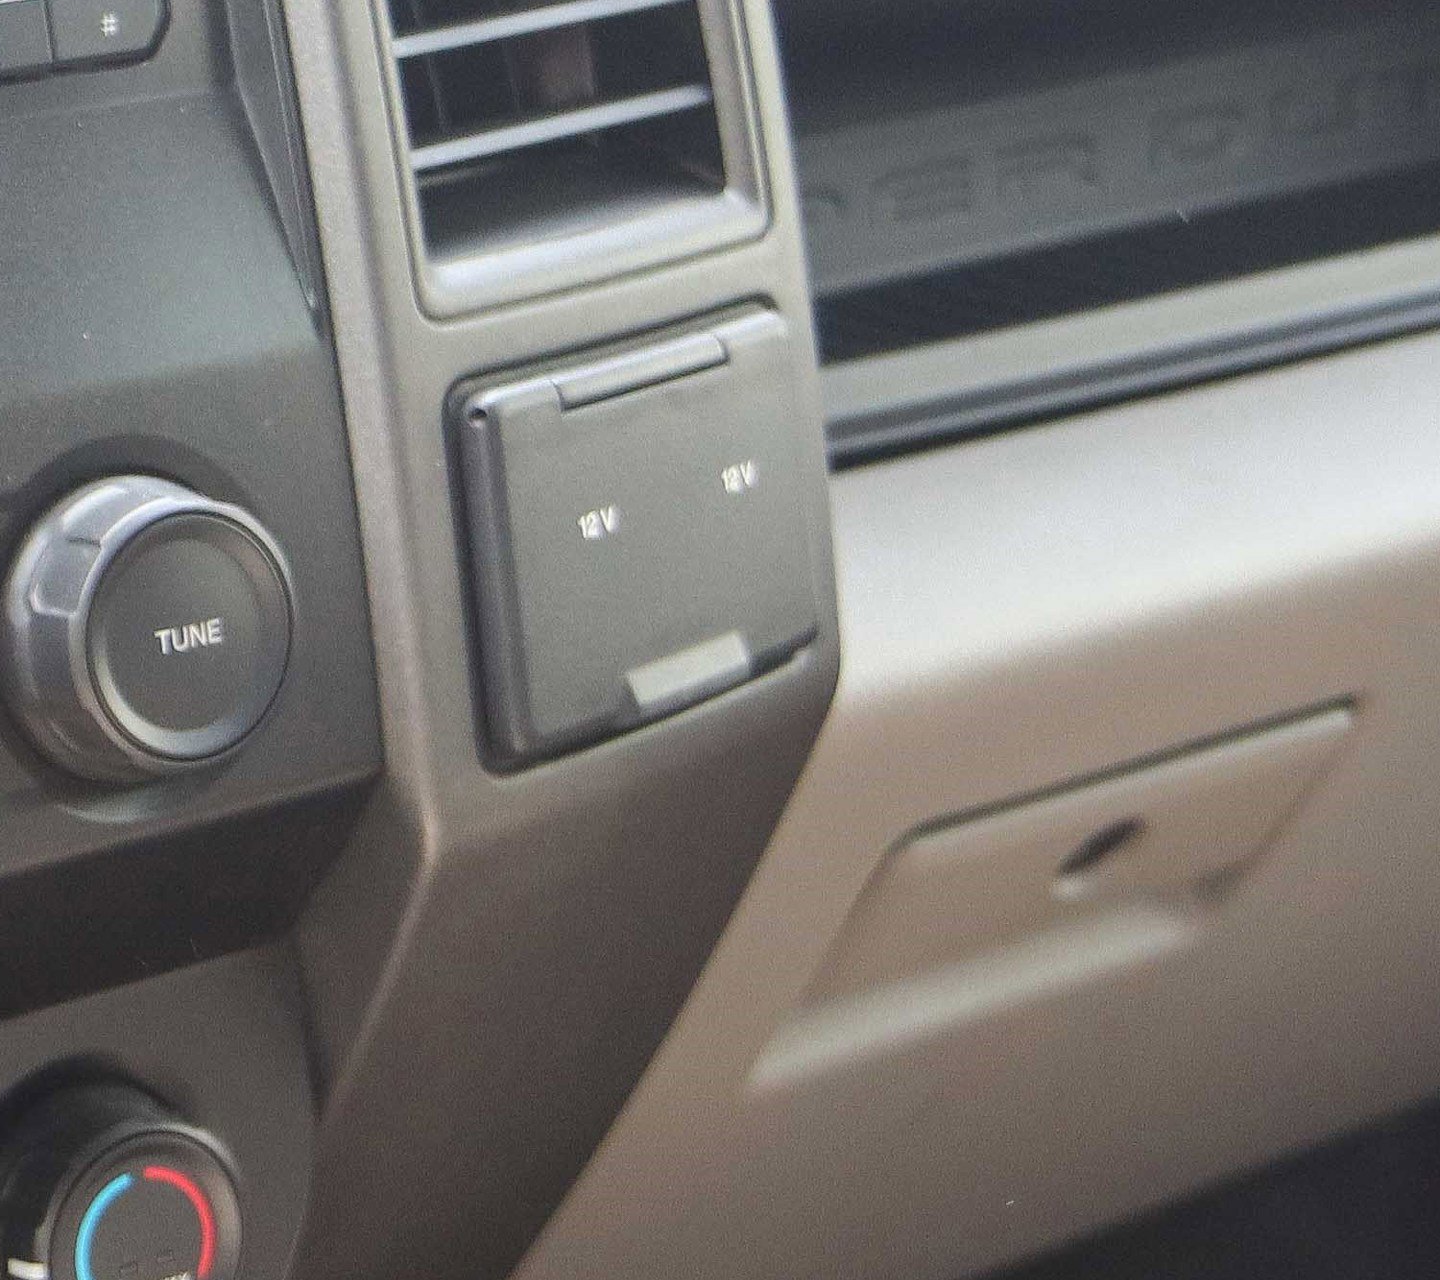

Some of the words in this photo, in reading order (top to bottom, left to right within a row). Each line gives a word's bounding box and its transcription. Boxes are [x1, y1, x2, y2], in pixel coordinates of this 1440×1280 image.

[722, 461, 757, 494] 12V
[579, 507, 618, 540] 12V
[155, 618, 224, 655] TUNE
